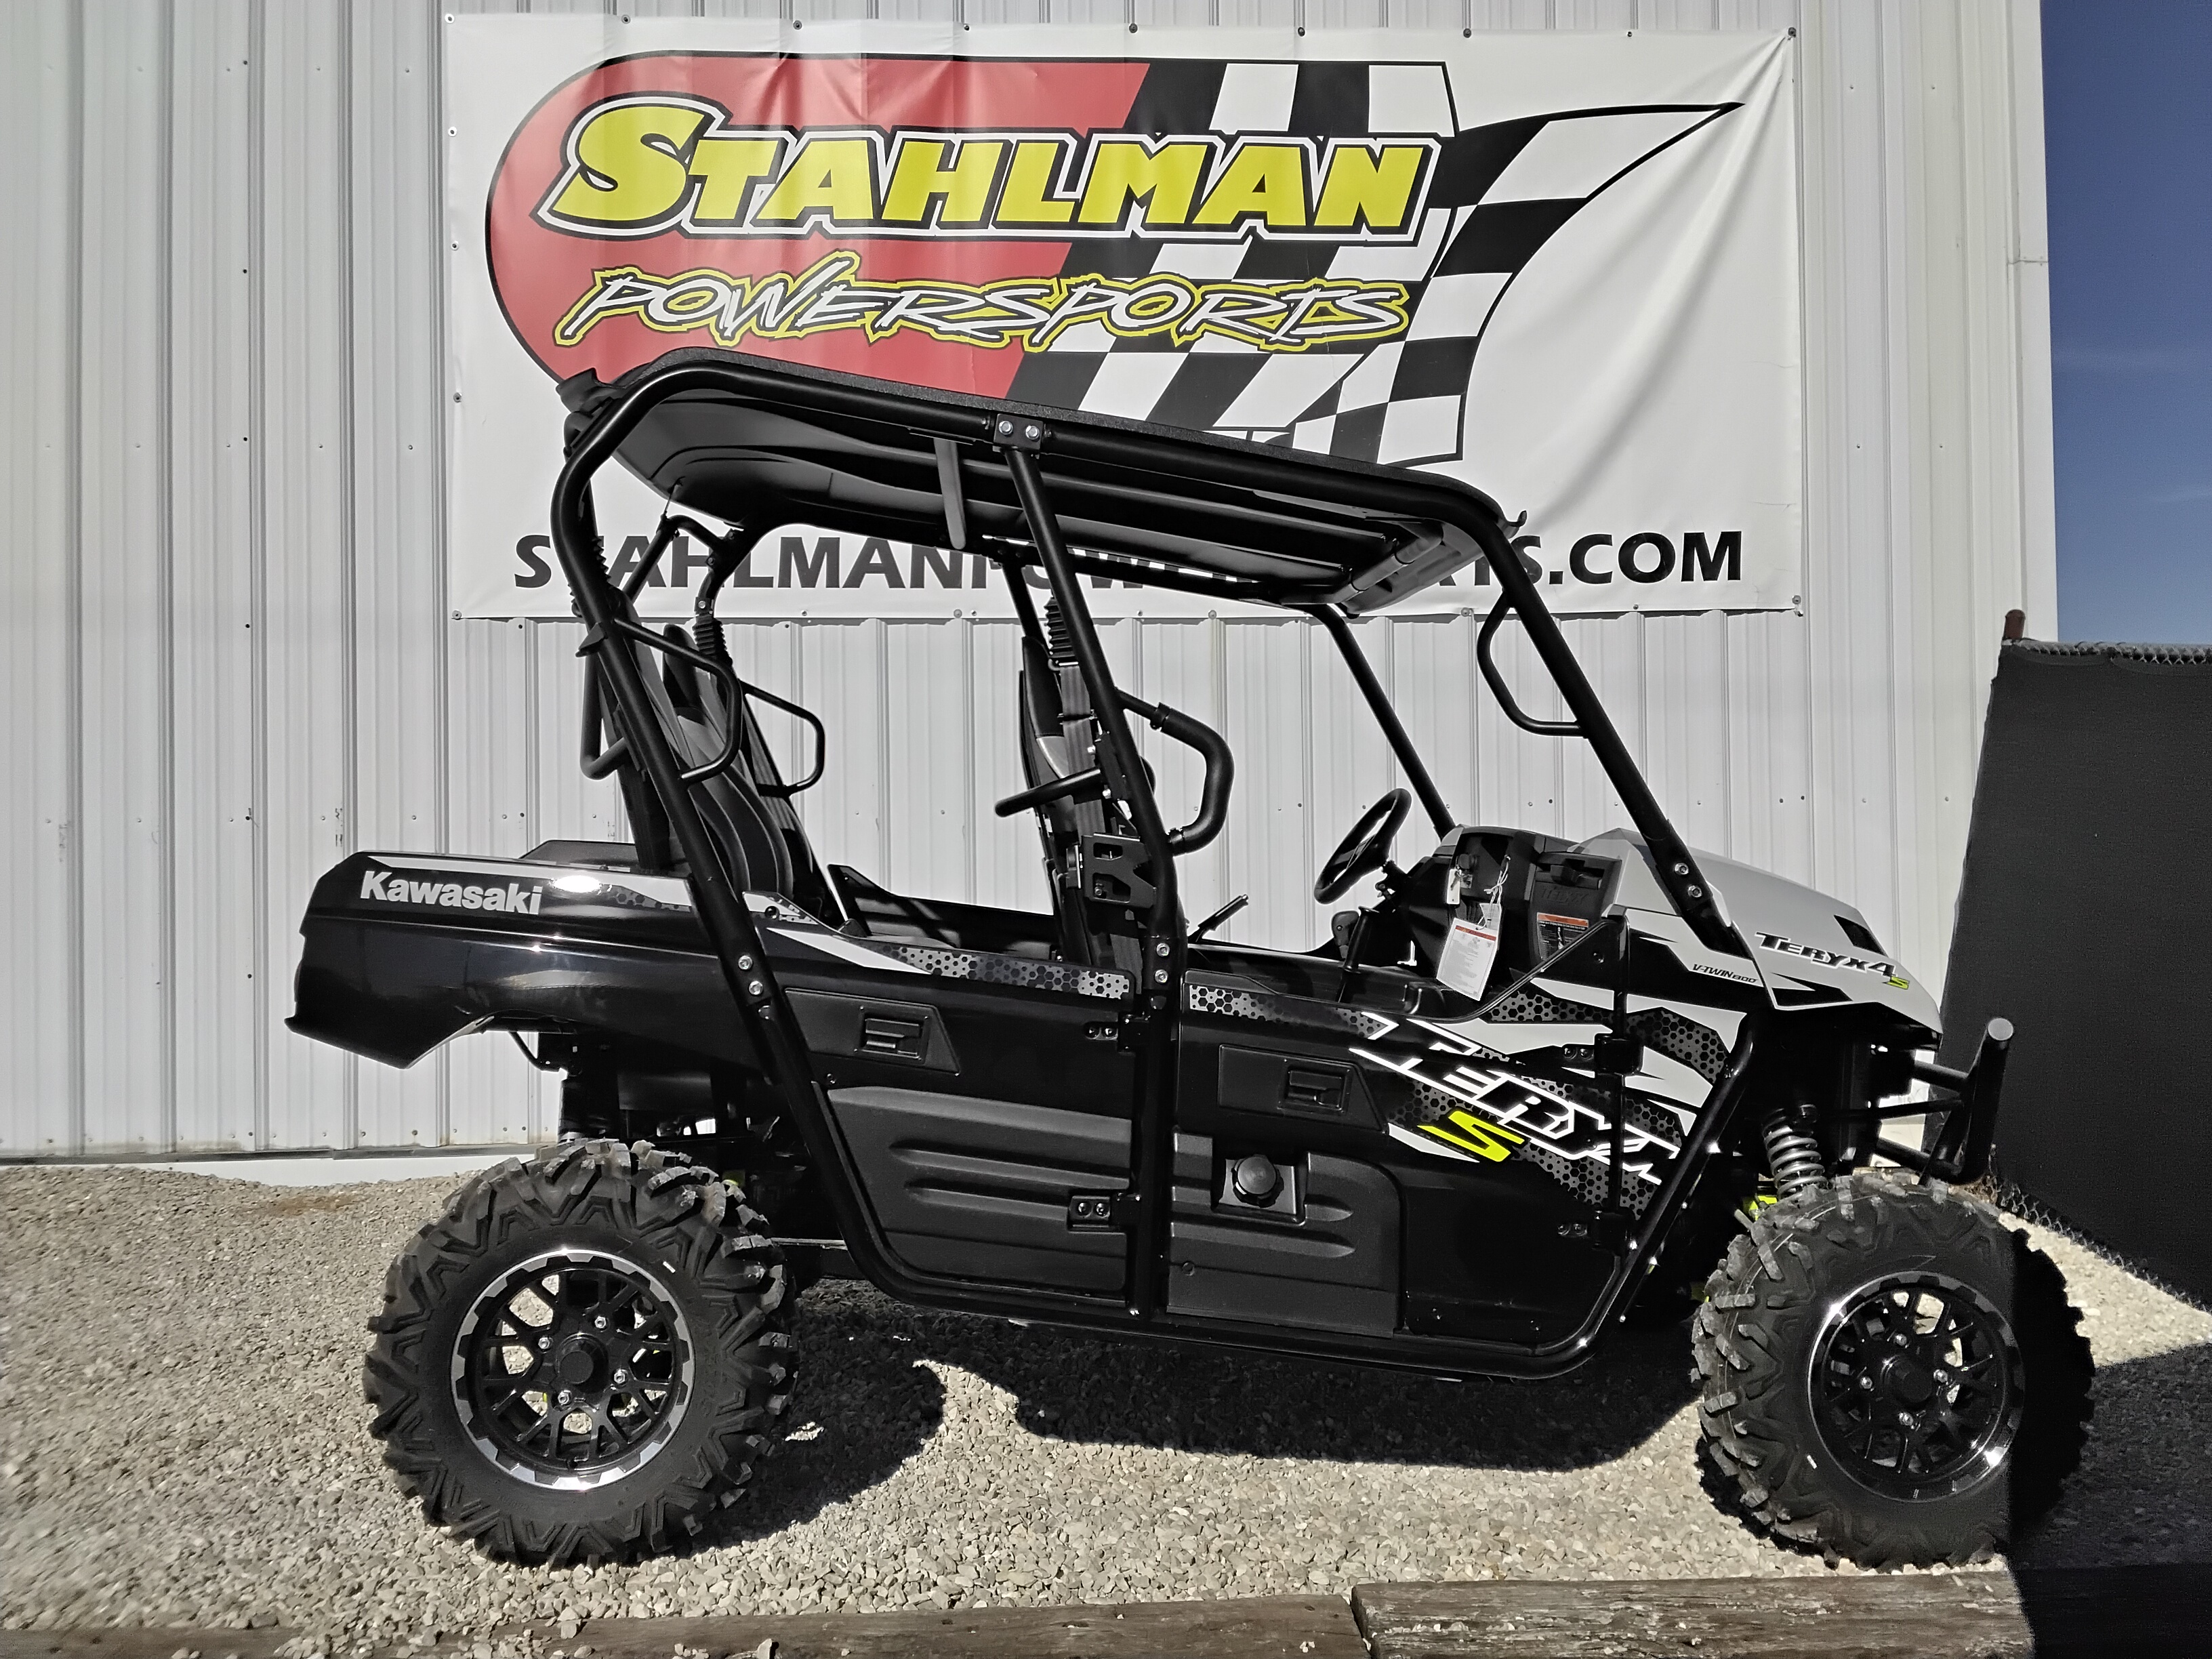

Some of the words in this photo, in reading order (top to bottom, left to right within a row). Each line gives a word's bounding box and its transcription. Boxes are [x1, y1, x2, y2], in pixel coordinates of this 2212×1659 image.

[535, 94, 1442, 241] STAHLMAN
[554, 251, 1412, 354] POWERSPORTS
[361, 870, 541, 915] Kawasaki
